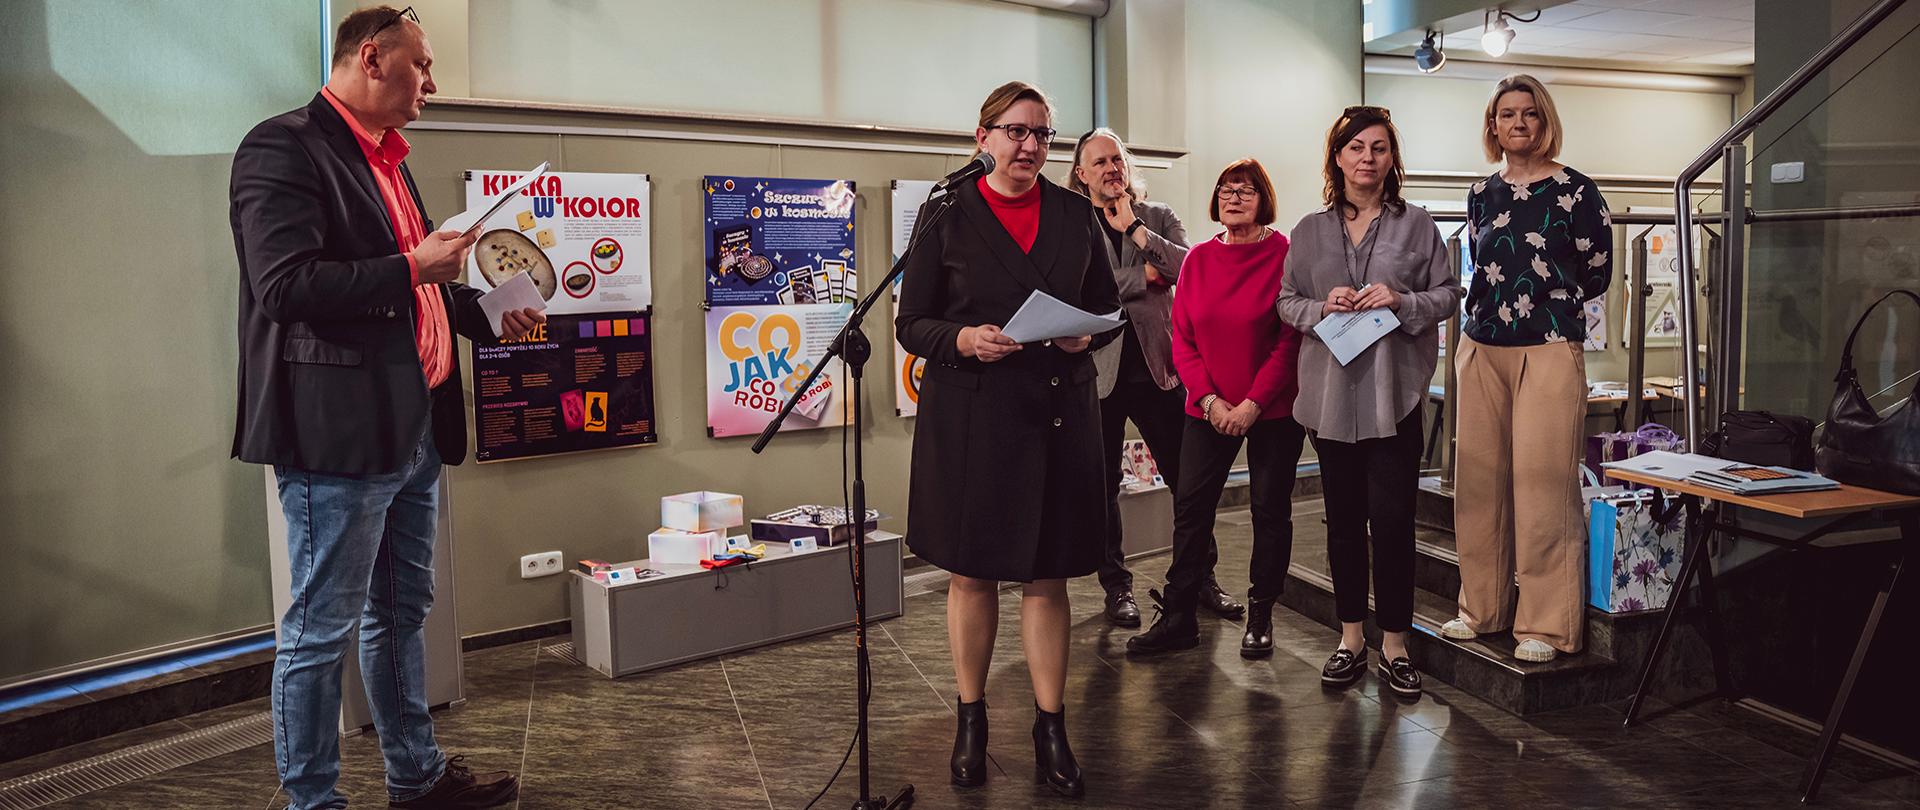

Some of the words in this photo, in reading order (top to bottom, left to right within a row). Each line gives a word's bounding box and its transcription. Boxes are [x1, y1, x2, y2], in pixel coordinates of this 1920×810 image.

[534, 197, 554, 218] W
[563, 197, 641, 218] KOLOR
[719, 312, 801, 362] CO
[724, 347, 794, 393] JAK
[750, 378, 776, 396] CO
[734, 390, 784, 414] ROBI
